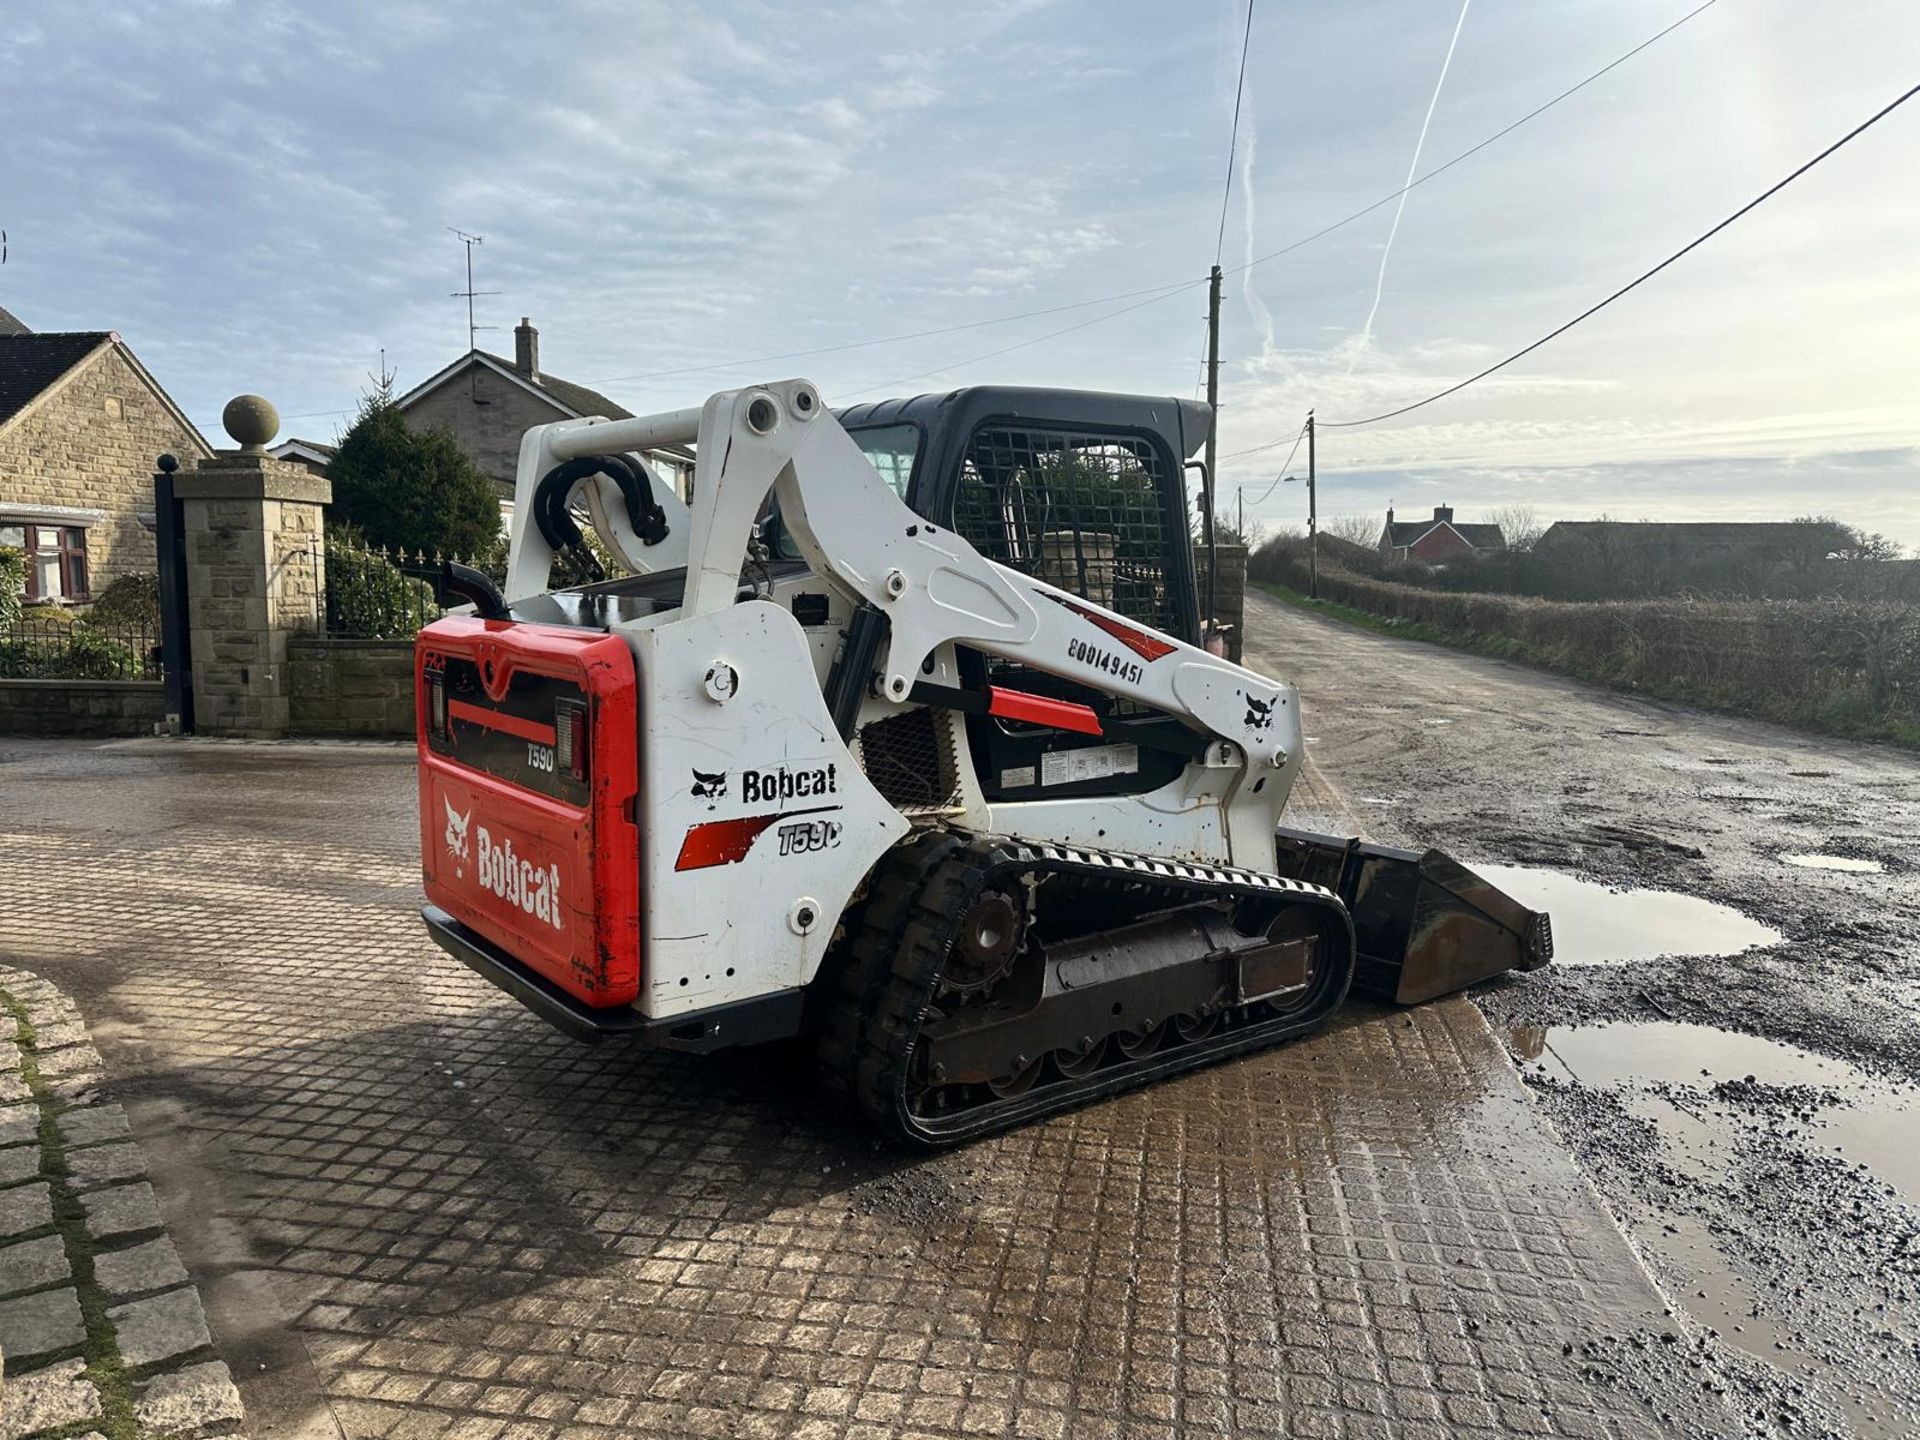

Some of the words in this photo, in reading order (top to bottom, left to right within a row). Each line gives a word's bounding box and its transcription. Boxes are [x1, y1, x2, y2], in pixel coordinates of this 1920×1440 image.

[1068, 638, 1143, 685] 800149451
[527, 742, 554, 773] T590
[742, 763, 837, 804] Bobcat
[477, 825, 562, 930] Bobcat
